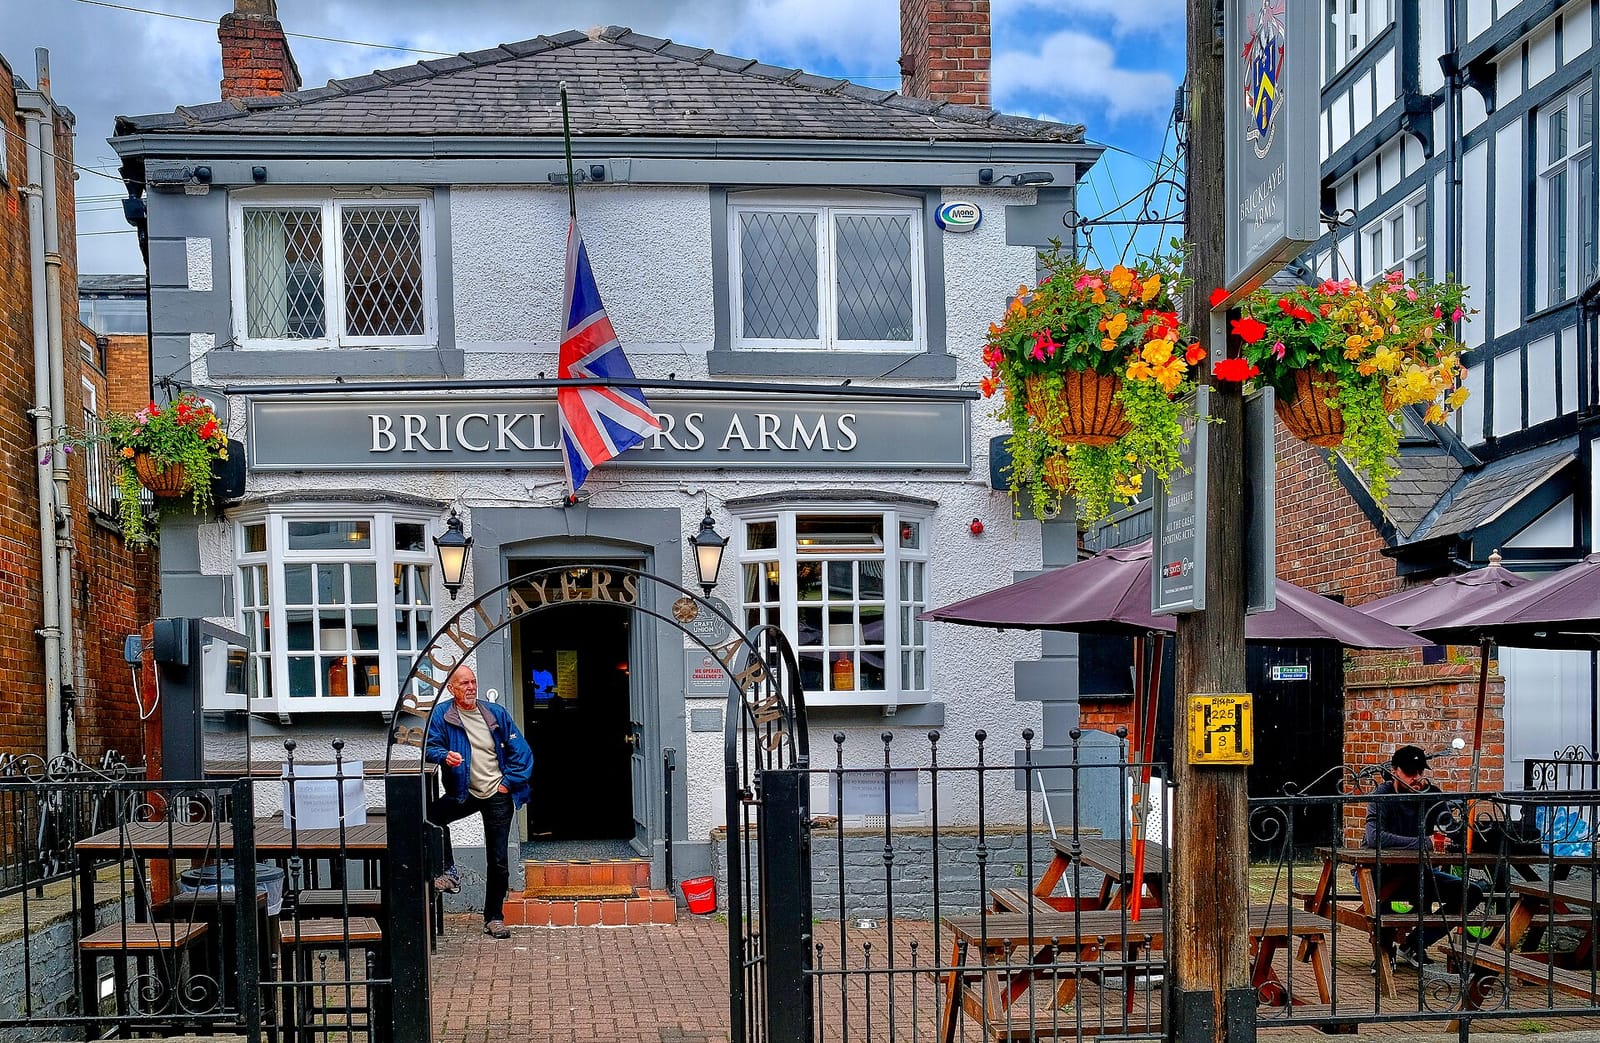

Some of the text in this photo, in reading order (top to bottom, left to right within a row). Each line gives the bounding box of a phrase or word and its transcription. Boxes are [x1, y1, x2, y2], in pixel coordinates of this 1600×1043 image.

[952, 209, 974, 218] Mono
[1254, 195, 1277, 232] ARMS
[368, 413, 858, 452] BRICKLRS ARMS
[393, 569, 793, 752] BRICKLAYERS ARMS
[1211, 709, 1235, 720] 225
[1218, 735, 1227, 747] 3
